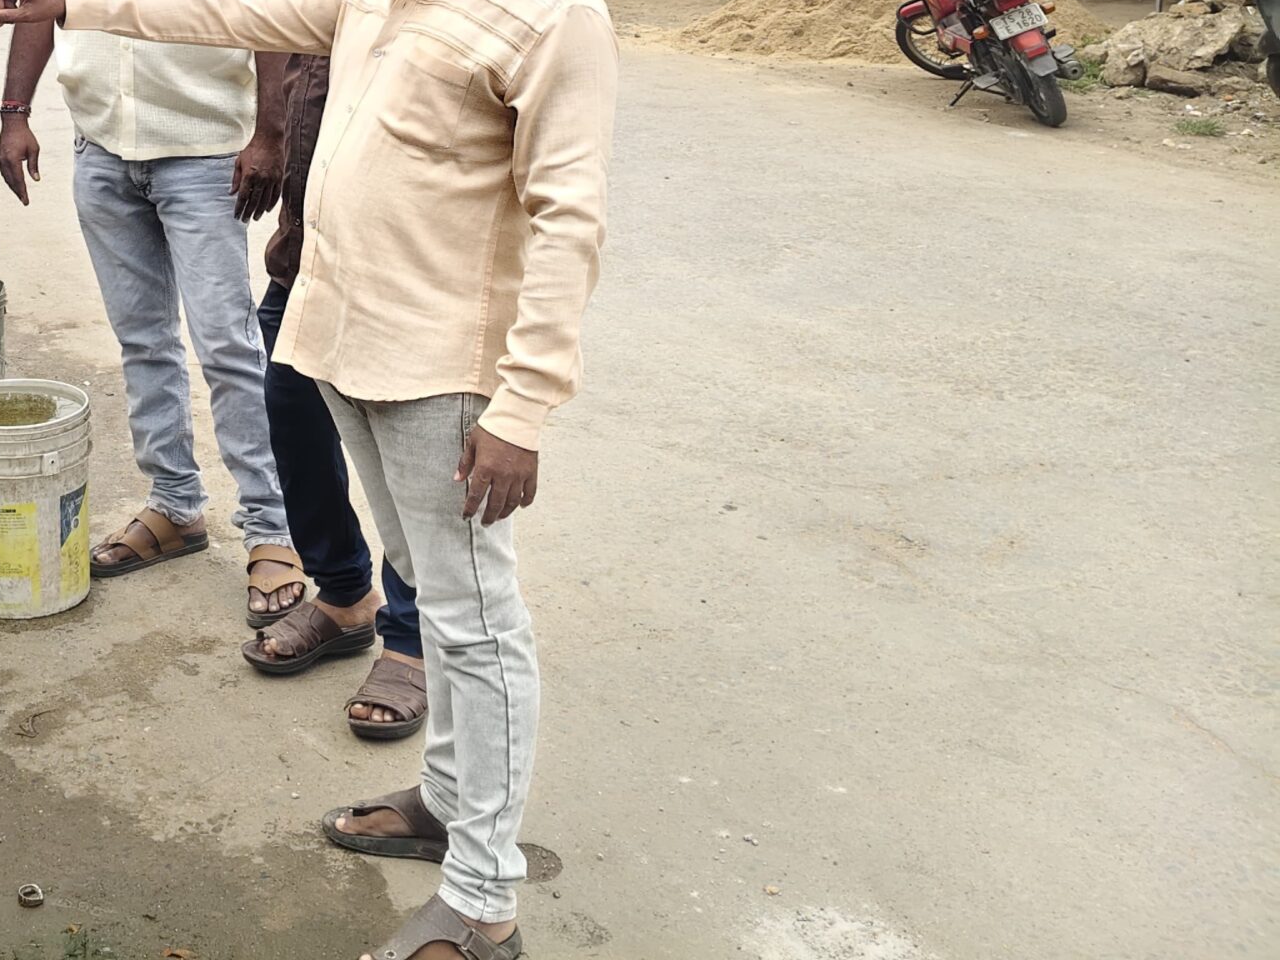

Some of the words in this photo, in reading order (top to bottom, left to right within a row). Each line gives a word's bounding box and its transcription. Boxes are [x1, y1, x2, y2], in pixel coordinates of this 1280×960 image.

[1000, 15, 1015, 25] TS
[1018, 8, 1034, 19] 28
[1016, 14, 1042, 30] 1620
